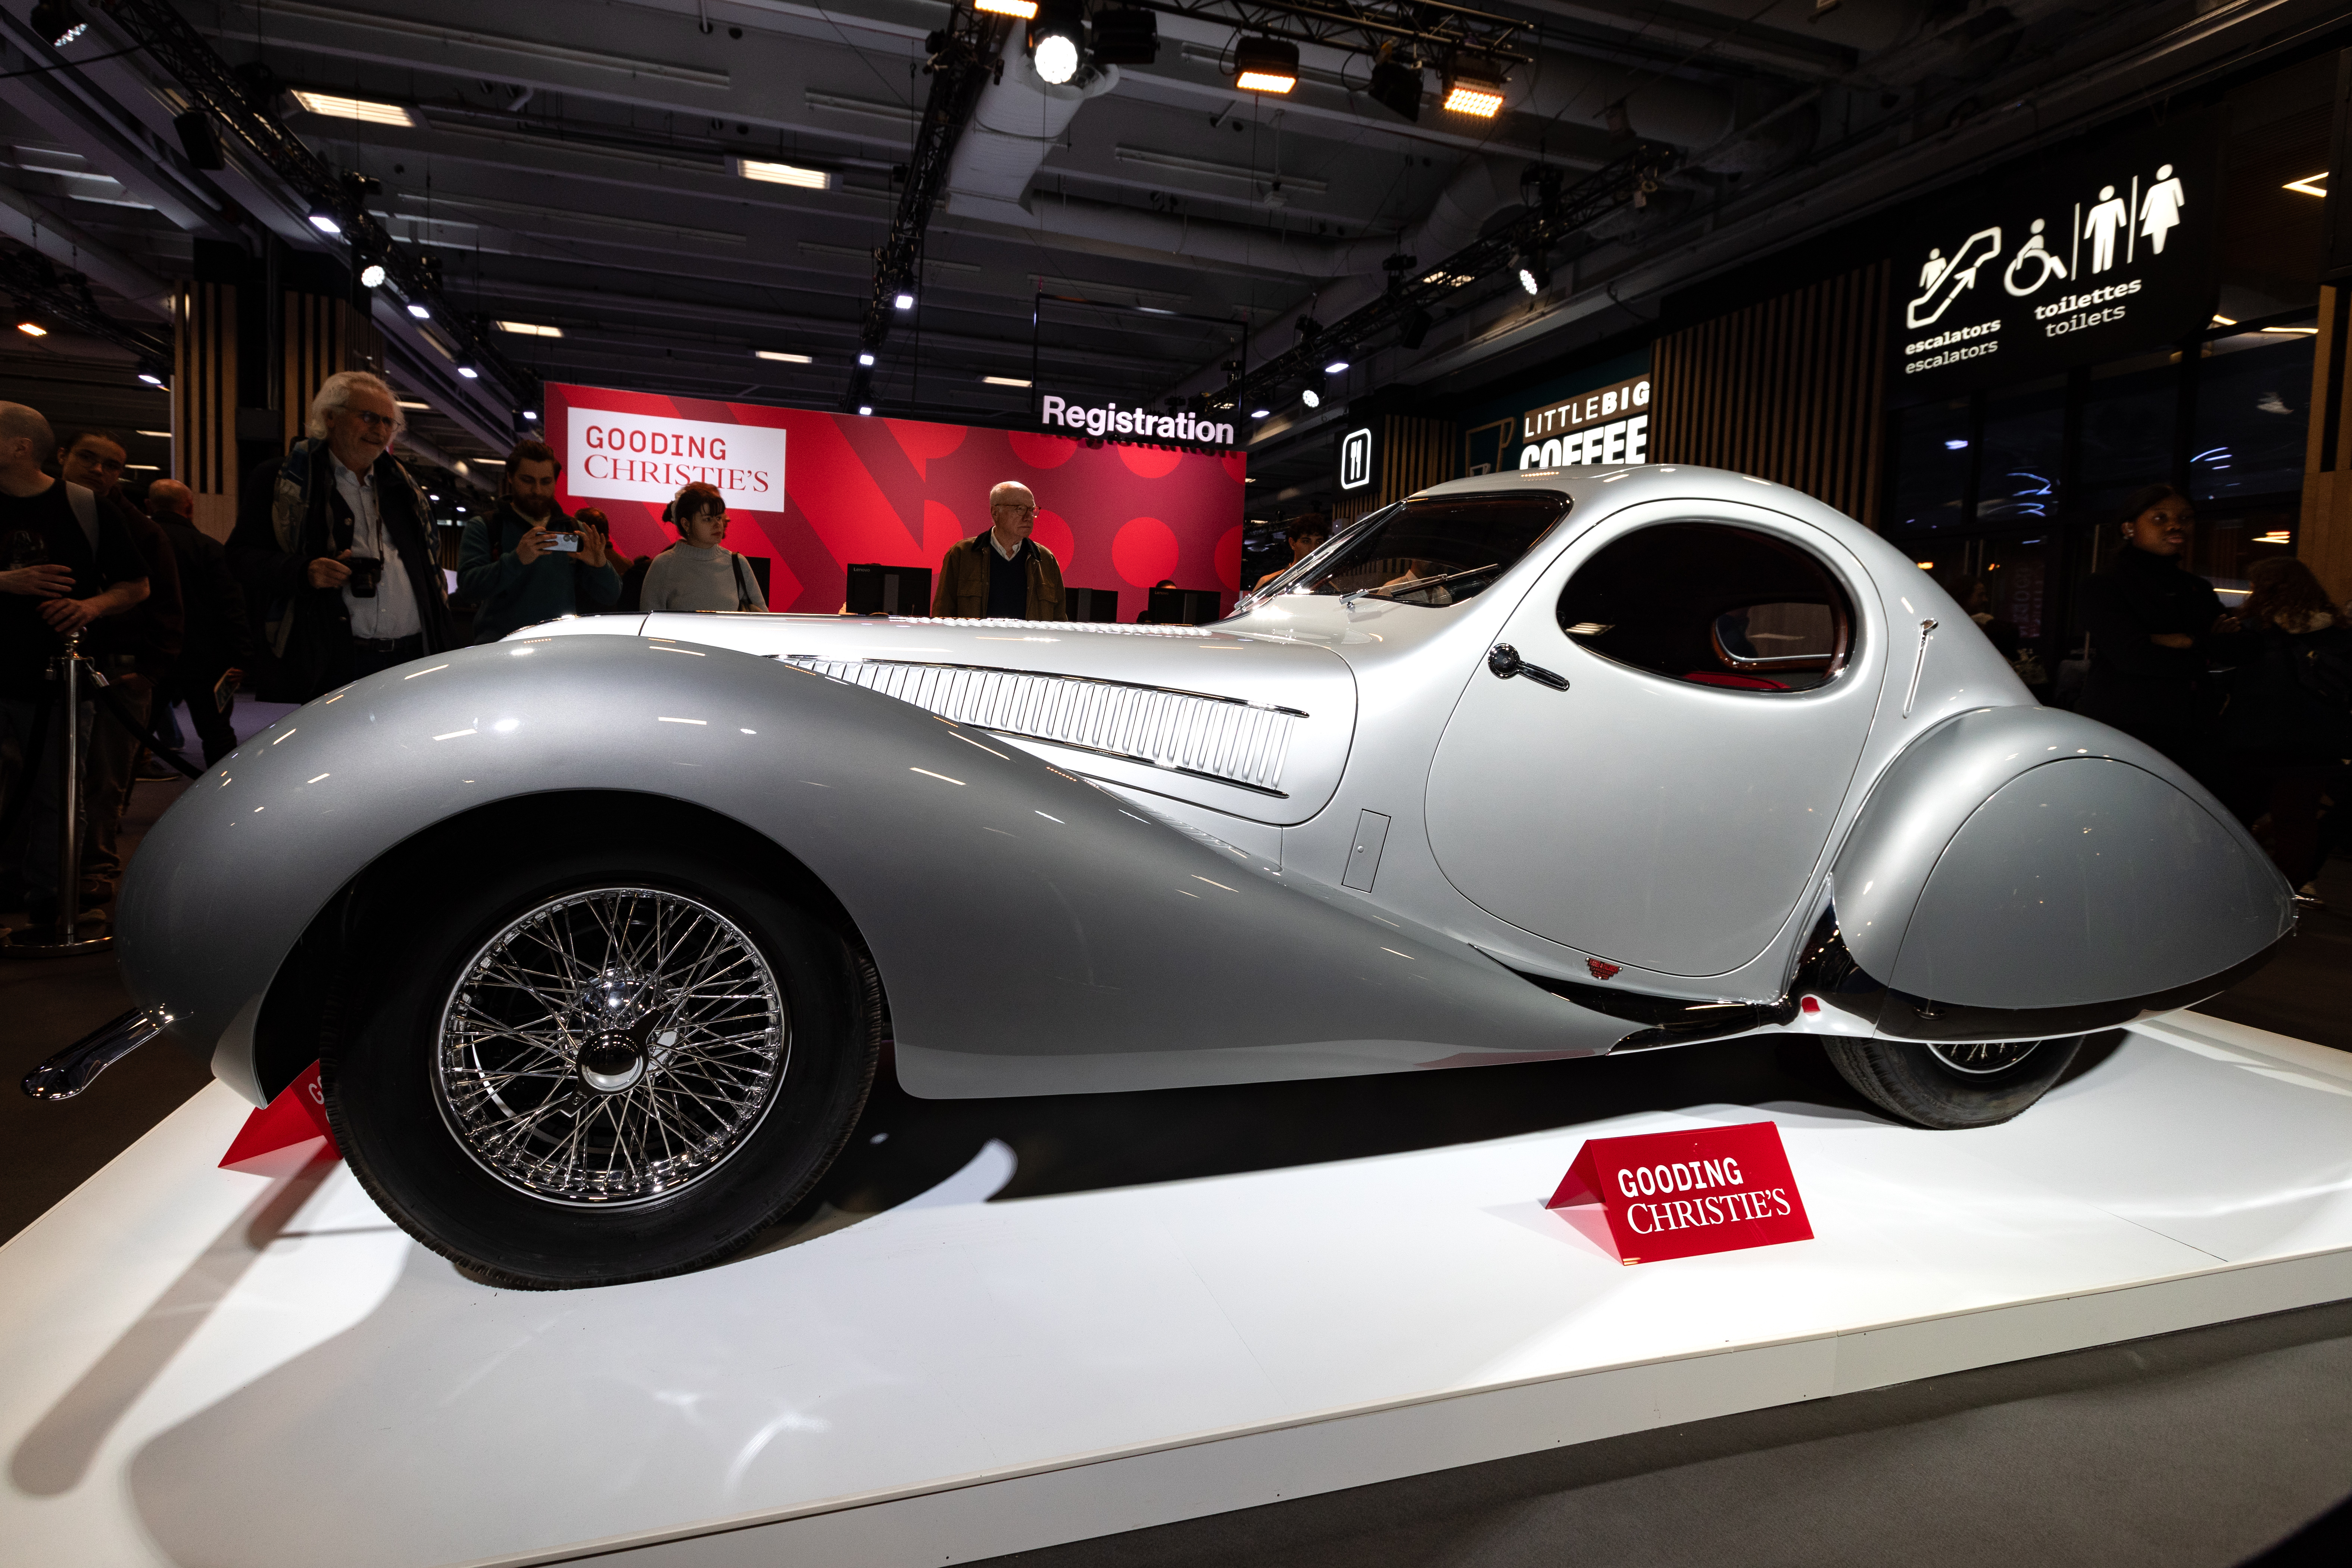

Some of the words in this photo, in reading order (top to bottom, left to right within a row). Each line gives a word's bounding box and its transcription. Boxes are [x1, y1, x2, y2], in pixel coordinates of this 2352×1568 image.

[2034, 279, 2142, 320] toilettes
[1905, 319, 2001, 355] escalators
[2045, 305, 2126, 337] toilets
[1905, 339, 1998, 374] escalators
[1043, 395, 1233, 444] Registration
[586, 425, 726, 460] GOODING
[1519, 415, 1648, 470] COFFEE
[584, 454, 769, 492] CHRISTIE'S
[1618, 1157, 1744, 1198] GOODING
[1627, 1188, 1791, 1235] CHRISTIE'S
